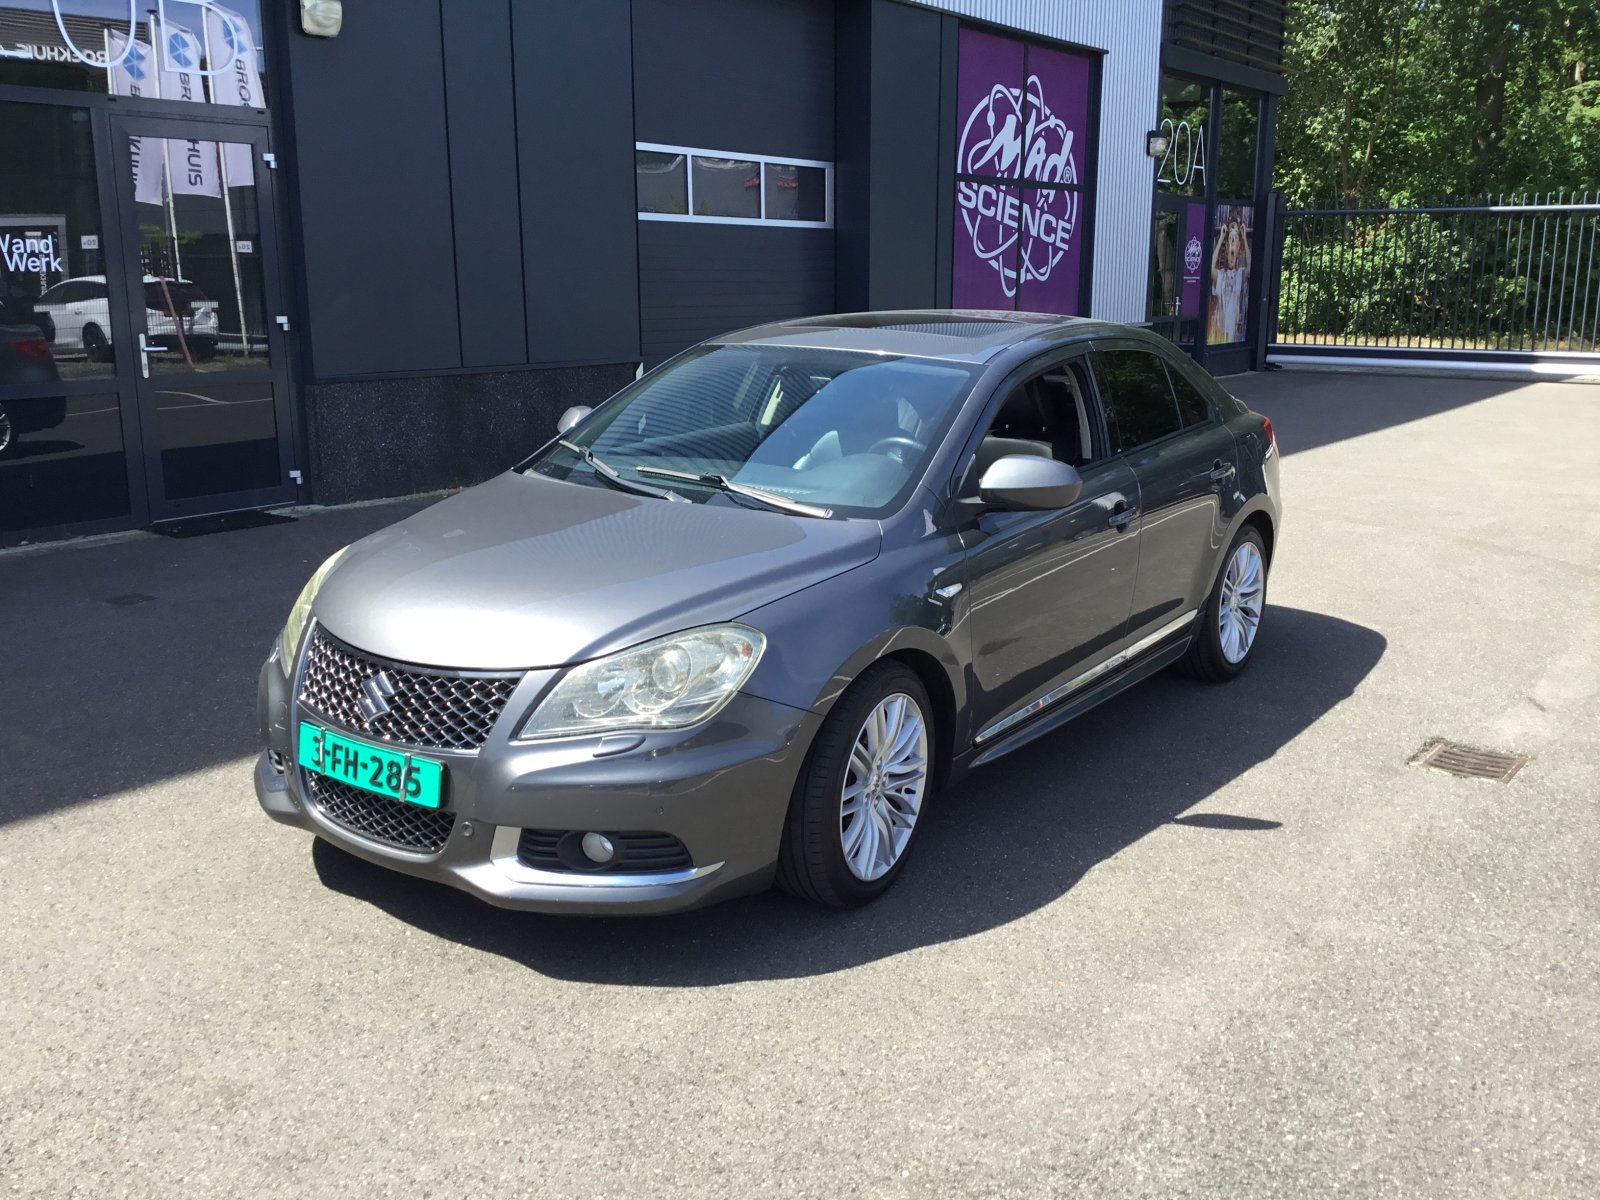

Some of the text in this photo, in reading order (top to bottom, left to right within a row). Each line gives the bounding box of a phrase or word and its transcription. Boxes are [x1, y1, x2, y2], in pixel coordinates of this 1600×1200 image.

[1157, 118, 1206, 187] 20A
[957, 181, 1072, 251] SCIENCE
[4, 253, 64, 272] Werk
